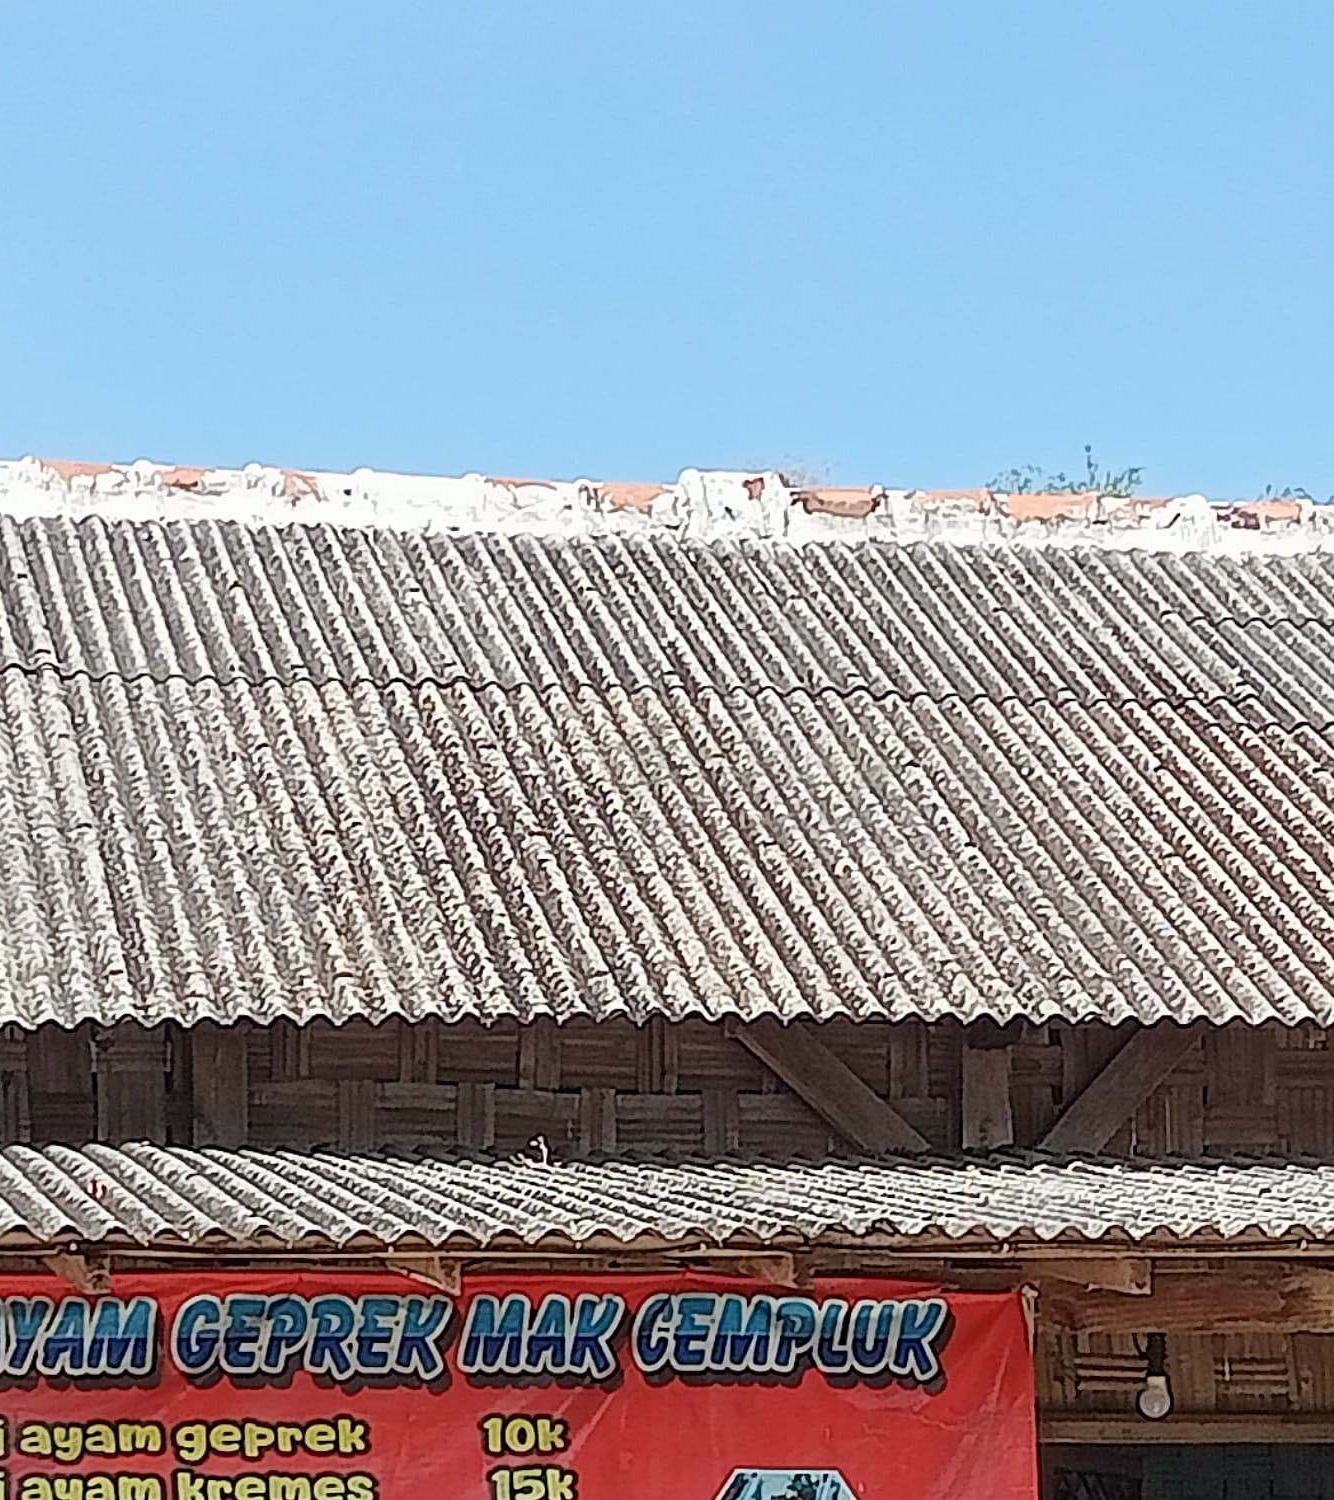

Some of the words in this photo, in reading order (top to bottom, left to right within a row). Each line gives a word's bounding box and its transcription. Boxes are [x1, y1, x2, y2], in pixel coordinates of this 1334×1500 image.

[170, 1293, 453, 1382] GEPREK
[458, 1294, 625, 1379] MAK
[633, 1294, 949, 1384] CEMPLUK
[18, 1424, 161, 1463] ayam
[175, 1418, 367, 1461] geprek
[481, 1417, 565, 1454] 10k
